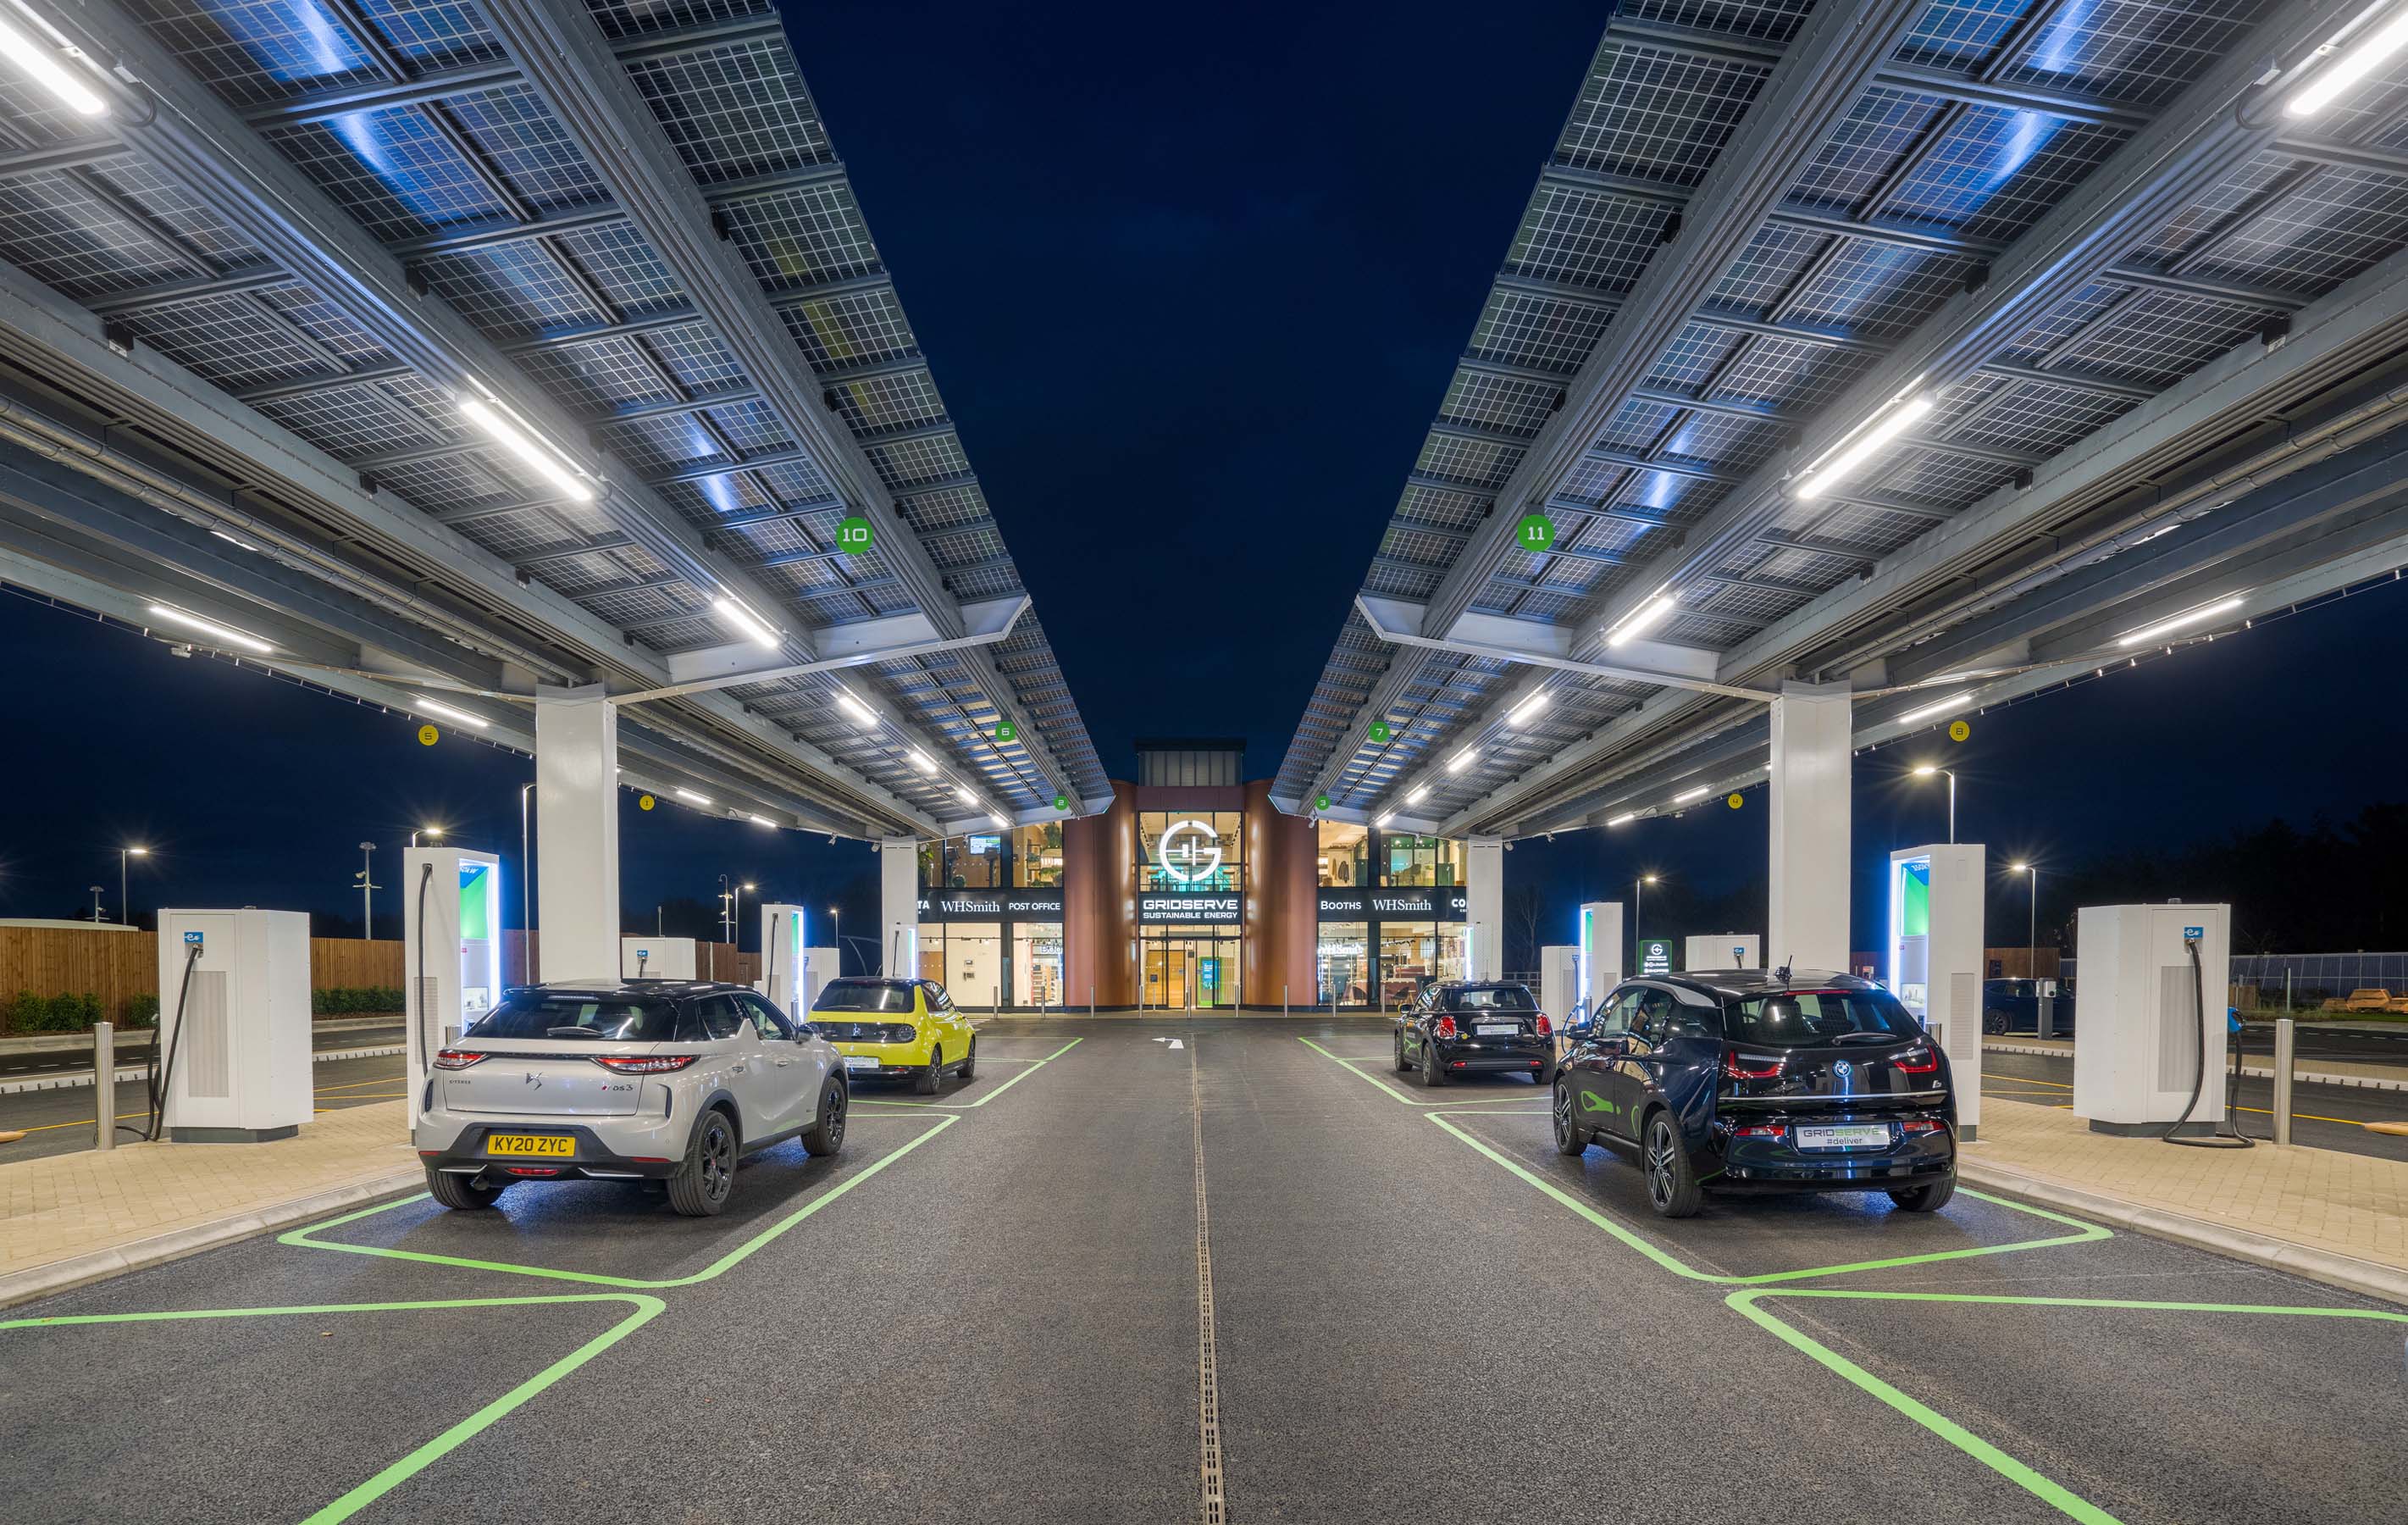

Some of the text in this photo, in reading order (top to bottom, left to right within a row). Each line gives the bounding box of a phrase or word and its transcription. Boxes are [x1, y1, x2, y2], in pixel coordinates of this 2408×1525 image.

[843, 528, 867, 542] 10
[1528, 526, 1545, 541] 11
[424, 732, 432, 740] 5
[1001, 728, 1010, 736] 6
[1376, 728, 1383, 736] 7
[941, 901, 1000, 912] WHSmith
[1009, 902, 1060, 911] POST OFFICE
[1143, 899, 1238, 910] GRIDSERVE
[1373, 899, 1431, 911] WHSmith
[1803, 1127, 1880, 1137] GRIDSERVE
[494, 1137, 567, 1153] KY20 ZYC
[1826, 1137, 1863, 1145] #deliver
